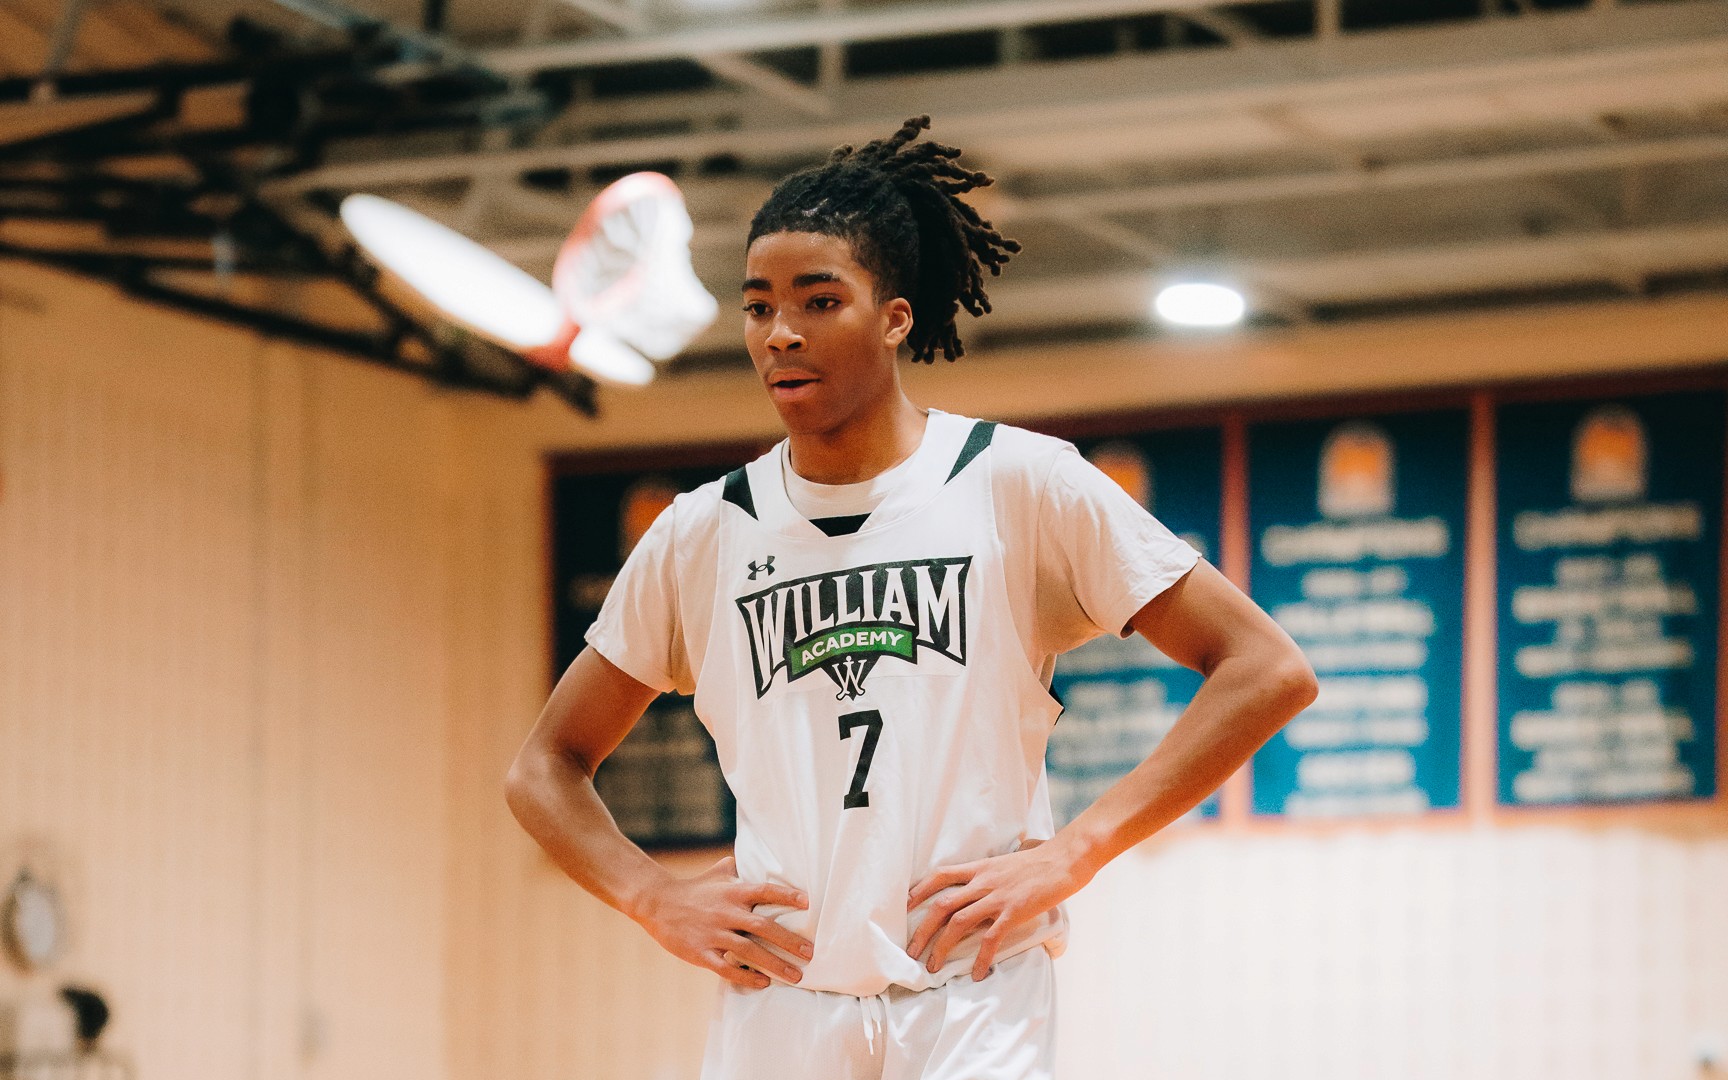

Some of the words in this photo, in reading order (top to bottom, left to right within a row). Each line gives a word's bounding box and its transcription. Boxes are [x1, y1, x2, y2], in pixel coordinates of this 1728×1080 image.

[739, 561, 969, 695] WILLIAM
[801, 631, 904, 667] ACADEMY
[838, 709, 883, 810] 7
